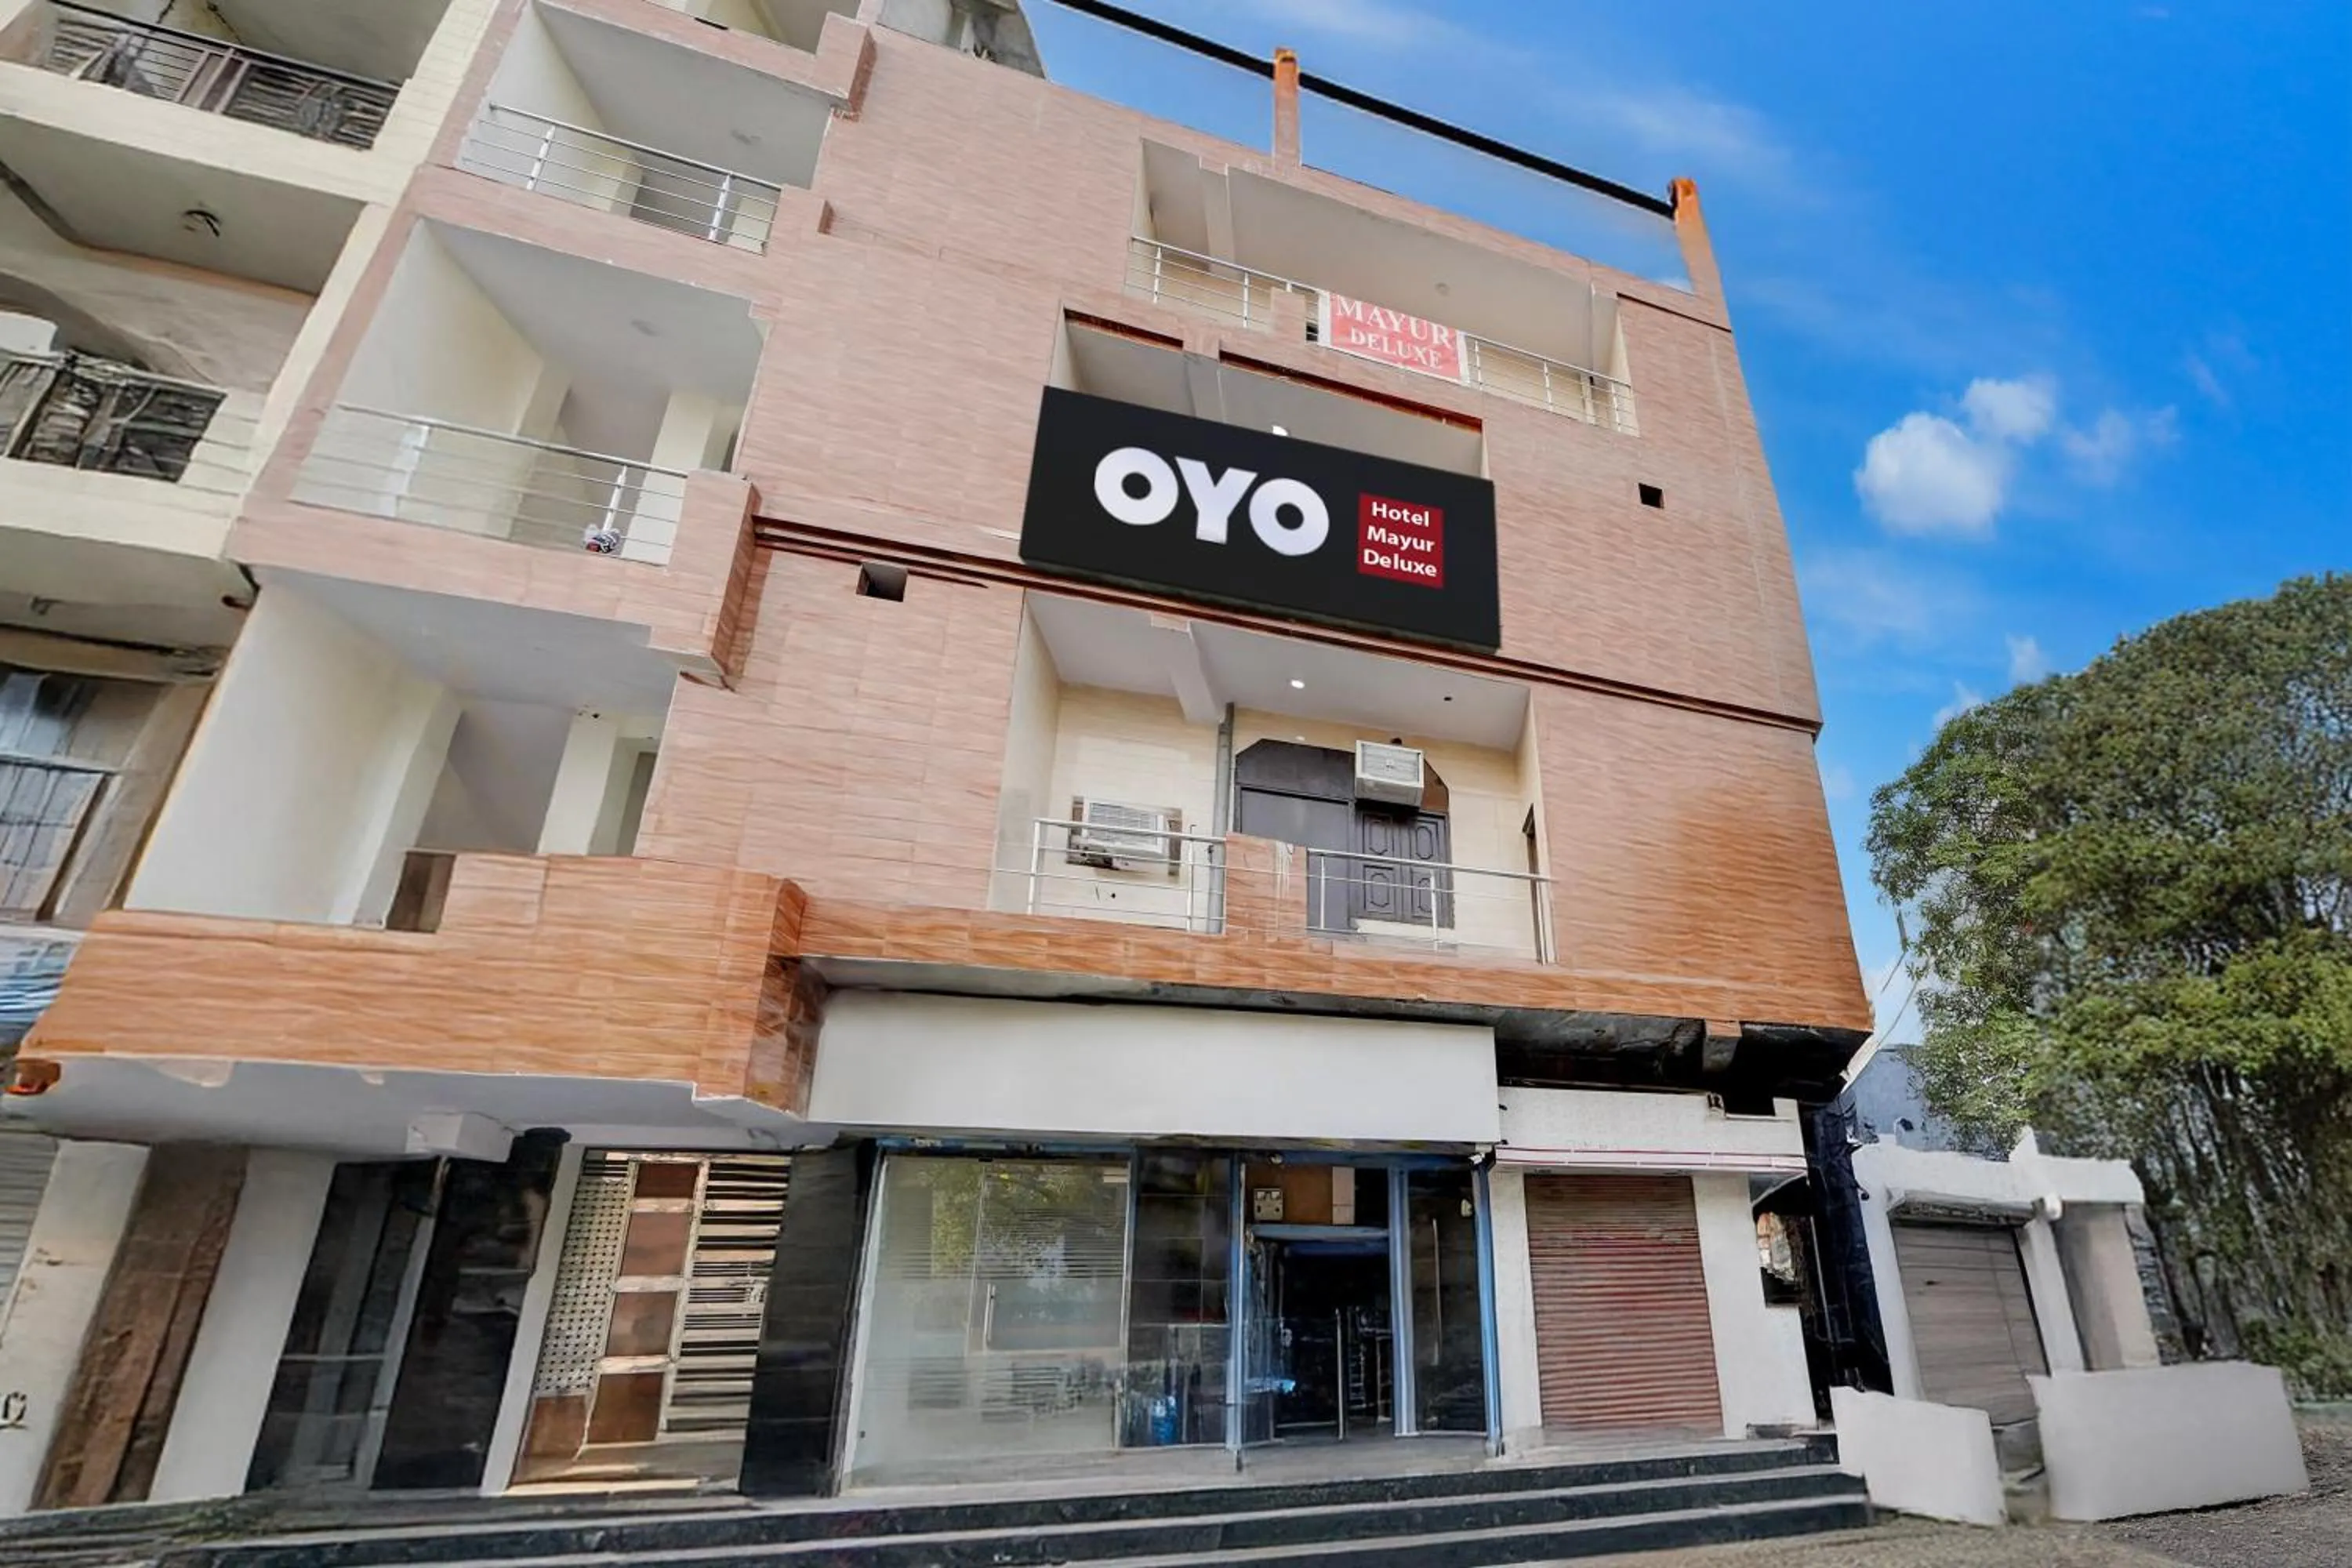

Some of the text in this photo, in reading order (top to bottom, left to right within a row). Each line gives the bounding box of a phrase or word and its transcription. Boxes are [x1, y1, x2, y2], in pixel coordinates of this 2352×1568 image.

[1336, 296, 1451, 349] MAYUR
[1351, 327, 1442, 369] DELUXE
[1094, 447, 1330, 556] OYO
[1371, 501, 1430, 528] Hotel
[1367, 524, 1436, 553] Mayur
[1363, 548, 1438, 577] Deluxe
